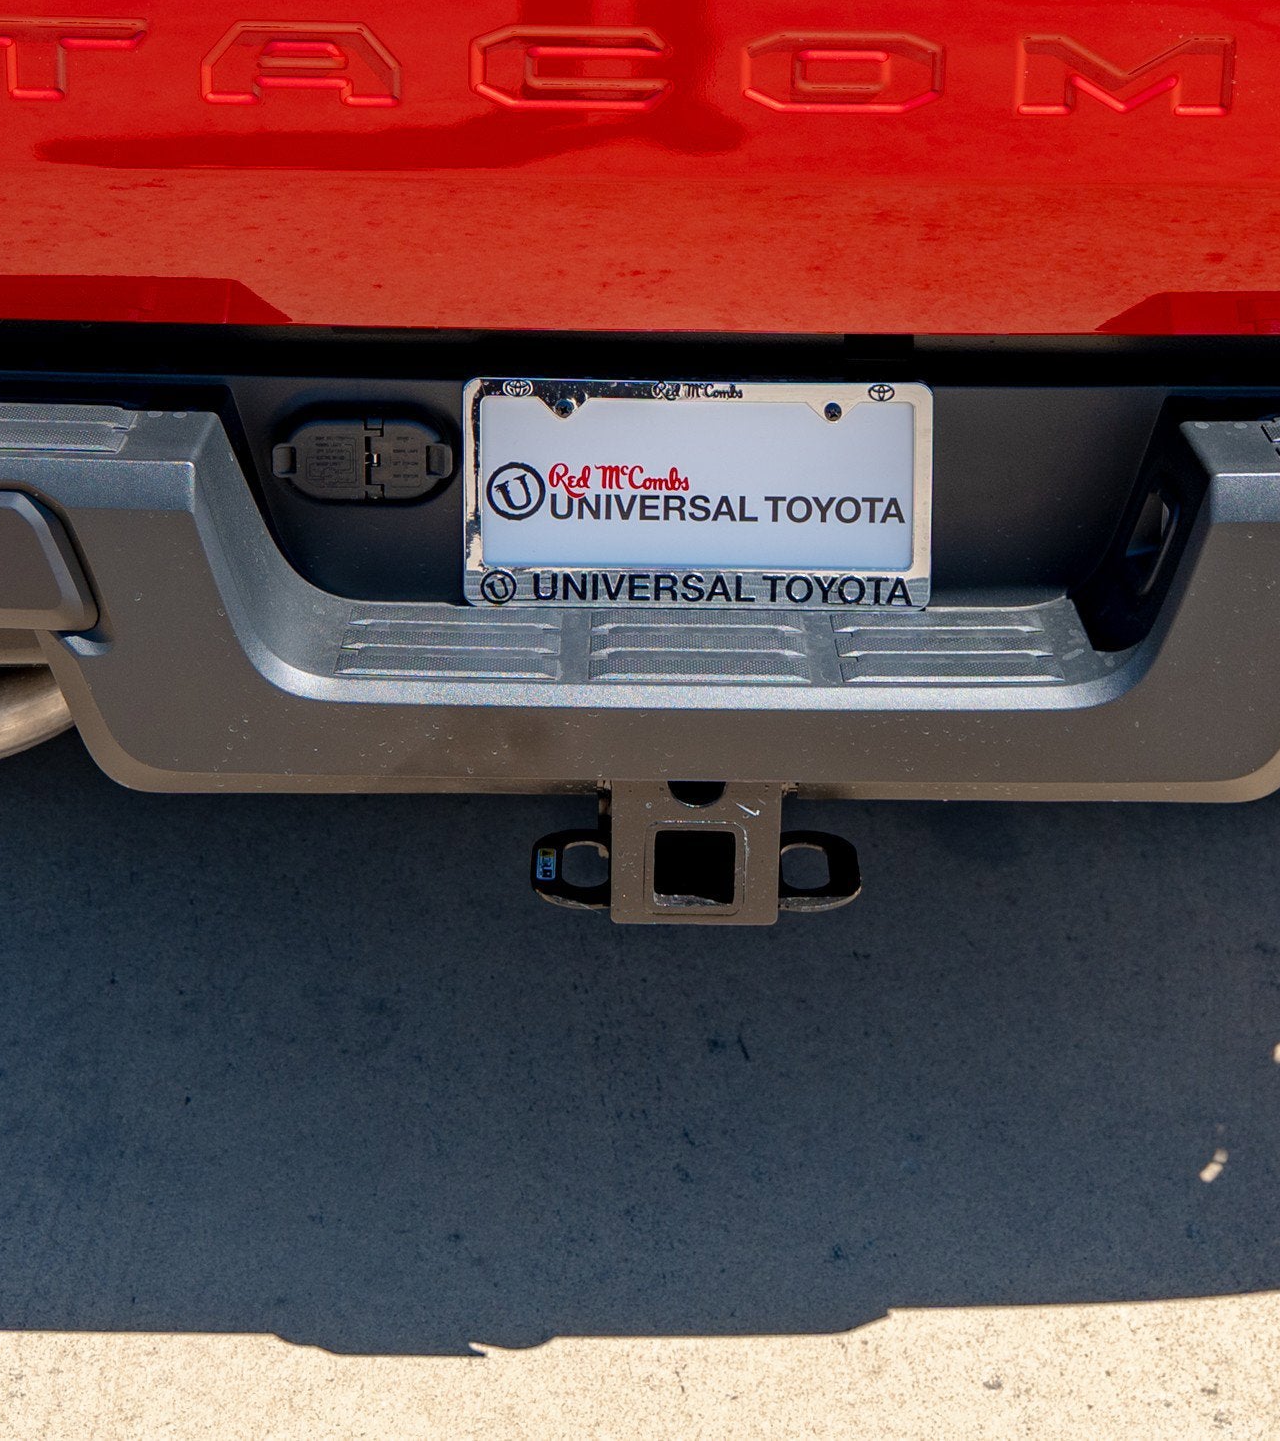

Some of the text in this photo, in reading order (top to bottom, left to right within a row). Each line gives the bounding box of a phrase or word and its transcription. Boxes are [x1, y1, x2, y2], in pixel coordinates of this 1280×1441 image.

[652, 381, 743, 401] Red McCombs
[549, 463, 689, 498] Red McCombs
[550, 493, 906, 524] UNIVERSAL TOYOTA
[533, 571, 756, 602] UNIVERSAL
[762, 573, 913, 607] TOYOTA
